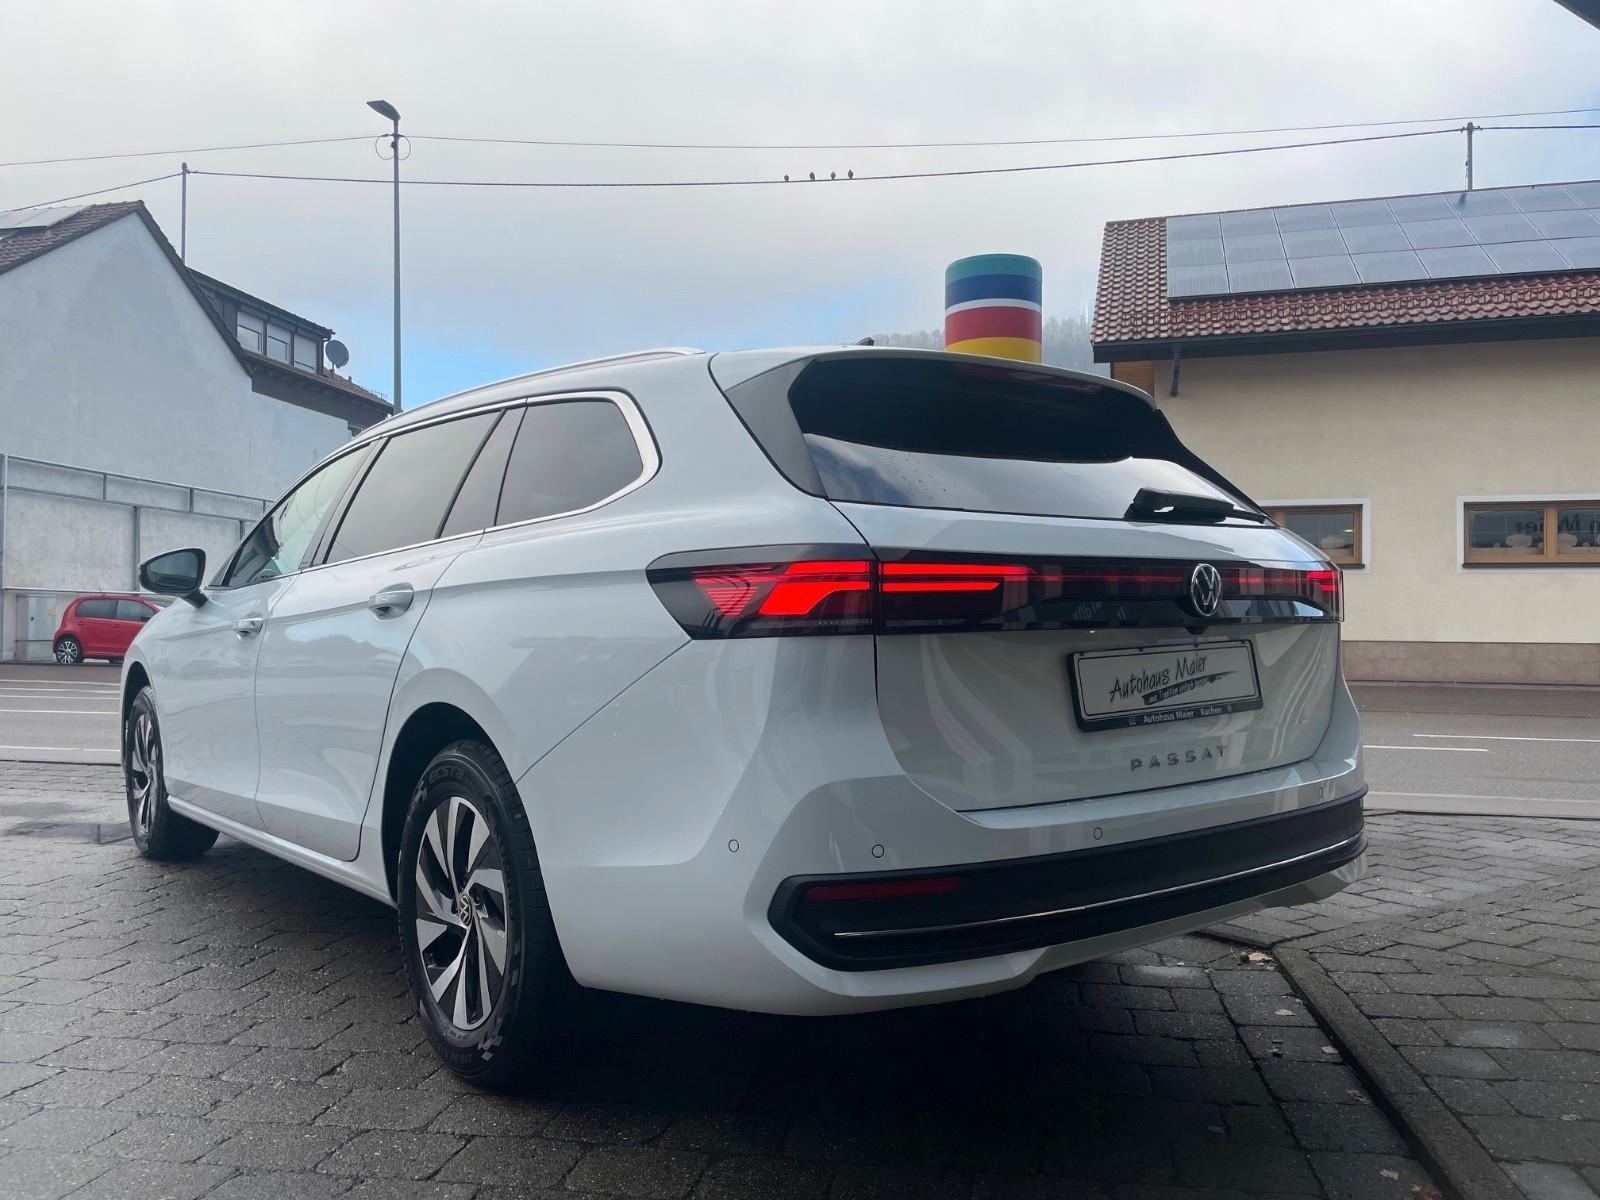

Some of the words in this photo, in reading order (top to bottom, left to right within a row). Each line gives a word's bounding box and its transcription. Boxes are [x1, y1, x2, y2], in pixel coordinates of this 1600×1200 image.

[1109, 668, 1170, 703] Autohaus
[1175, 653, 1209, 681] Maier
[1143, 712, 1175, 724] Autohaus
[1175, 710, 1194, 720] Maier
[1130, 745, 1227, 772] PASSAT
